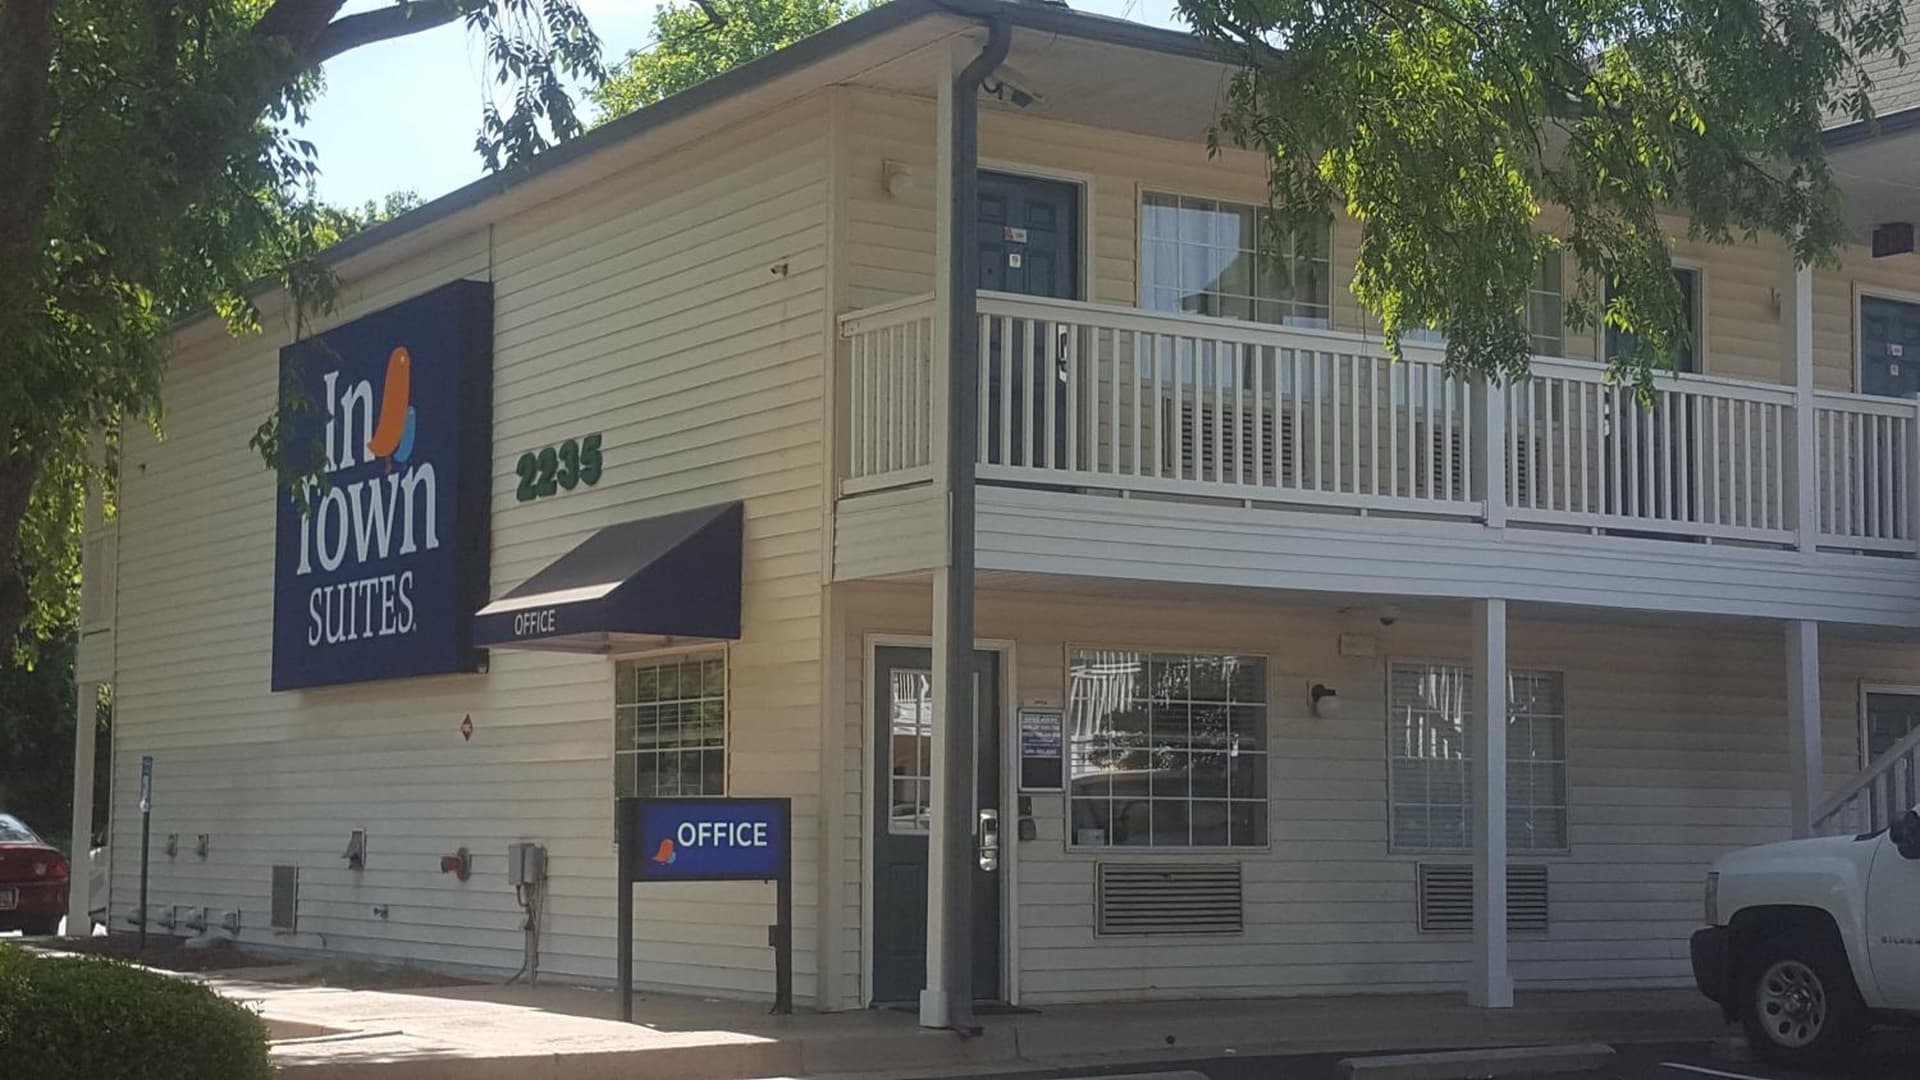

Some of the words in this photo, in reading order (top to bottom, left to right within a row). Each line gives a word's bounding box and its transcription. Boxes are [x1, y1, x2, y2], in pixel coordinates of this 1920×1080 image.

[324, 370, 375, 473] In
[516, 432, 603, 501] 2235
[514, 609, 556, 636] OFFICE
[677, 822, 768, 847] OFFICE
